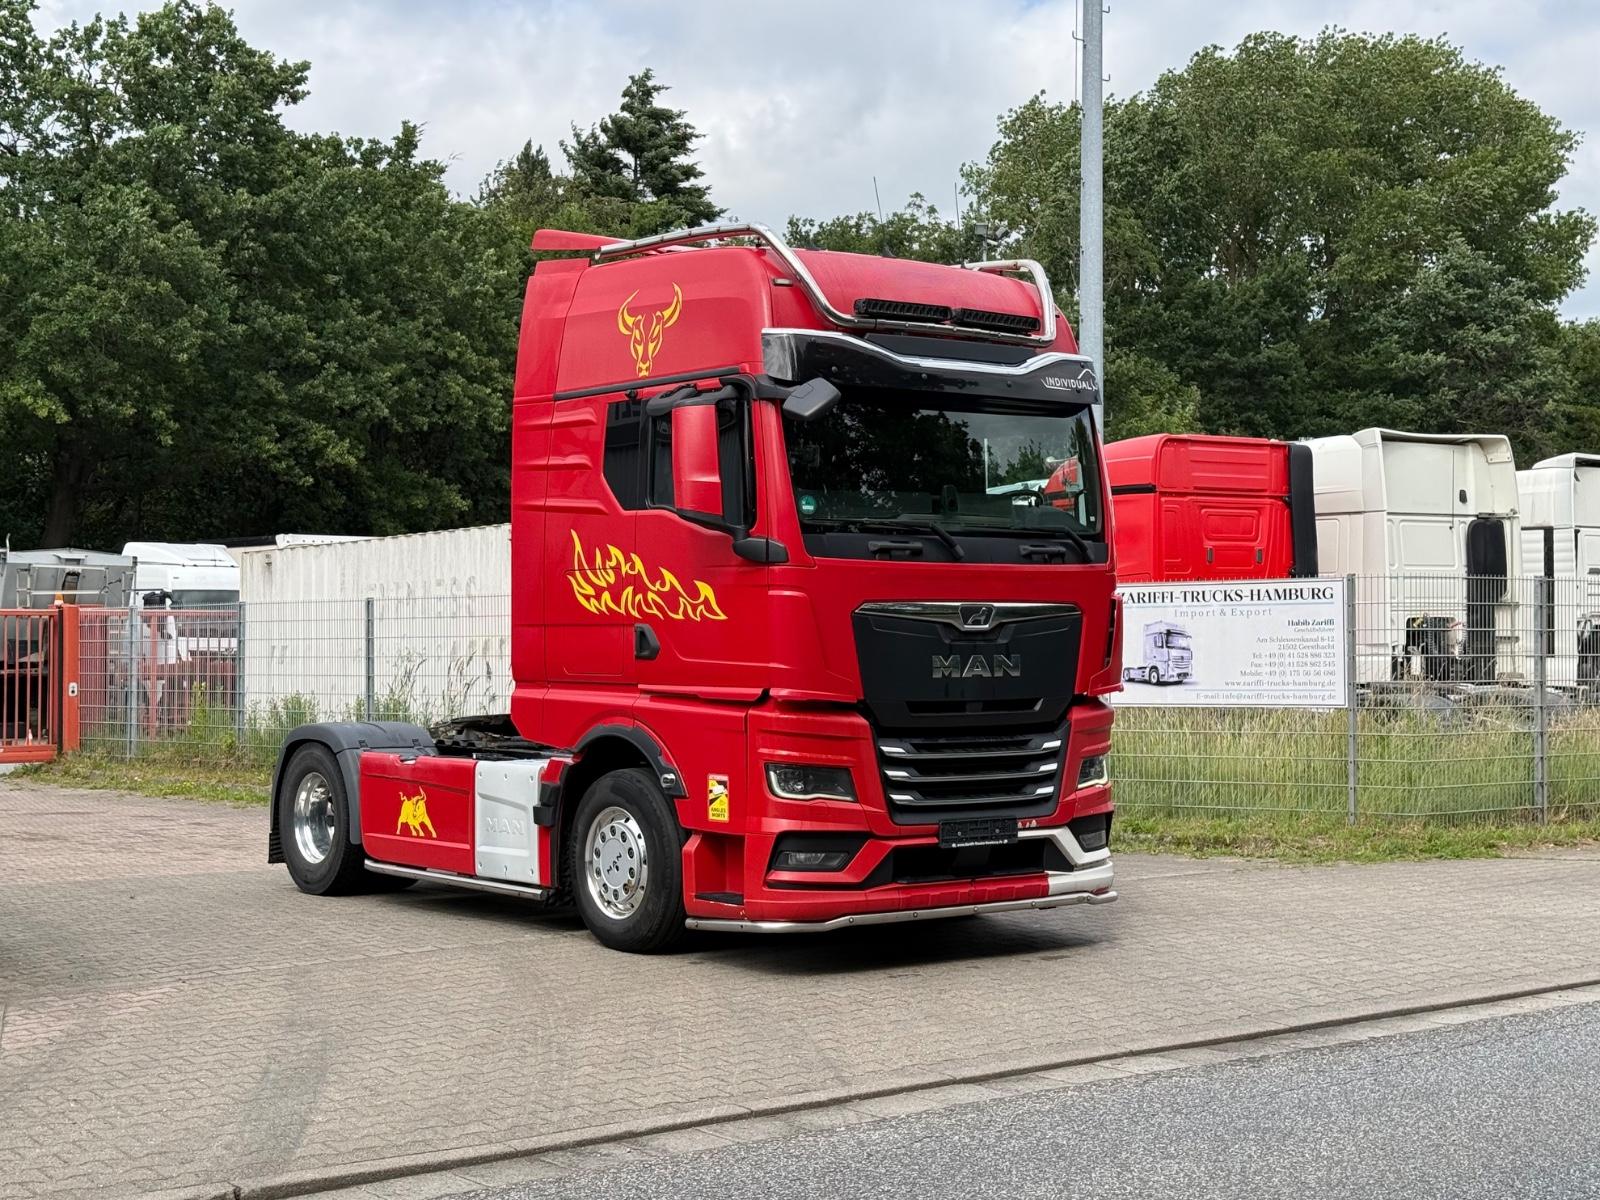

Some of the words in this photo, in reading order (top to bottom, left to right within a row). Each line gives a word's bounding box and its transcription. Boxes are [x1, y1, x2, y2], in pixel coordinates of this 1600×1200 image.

[1046, 377, 1092, 390] INDIVIDUAL
[1174, 609, 1215, 619] Import
[1219, 609, 1227, 617] &
[1231, 608, 1272, 618] Export
[1287, 619, 1310, 627] Habib
[1311, 618, 1335, 626] Zariffi
[932, 654, 1021, 678] MAN
[486, 817, 525, 835] MAN
[606, 852, 622, 875] MAN
